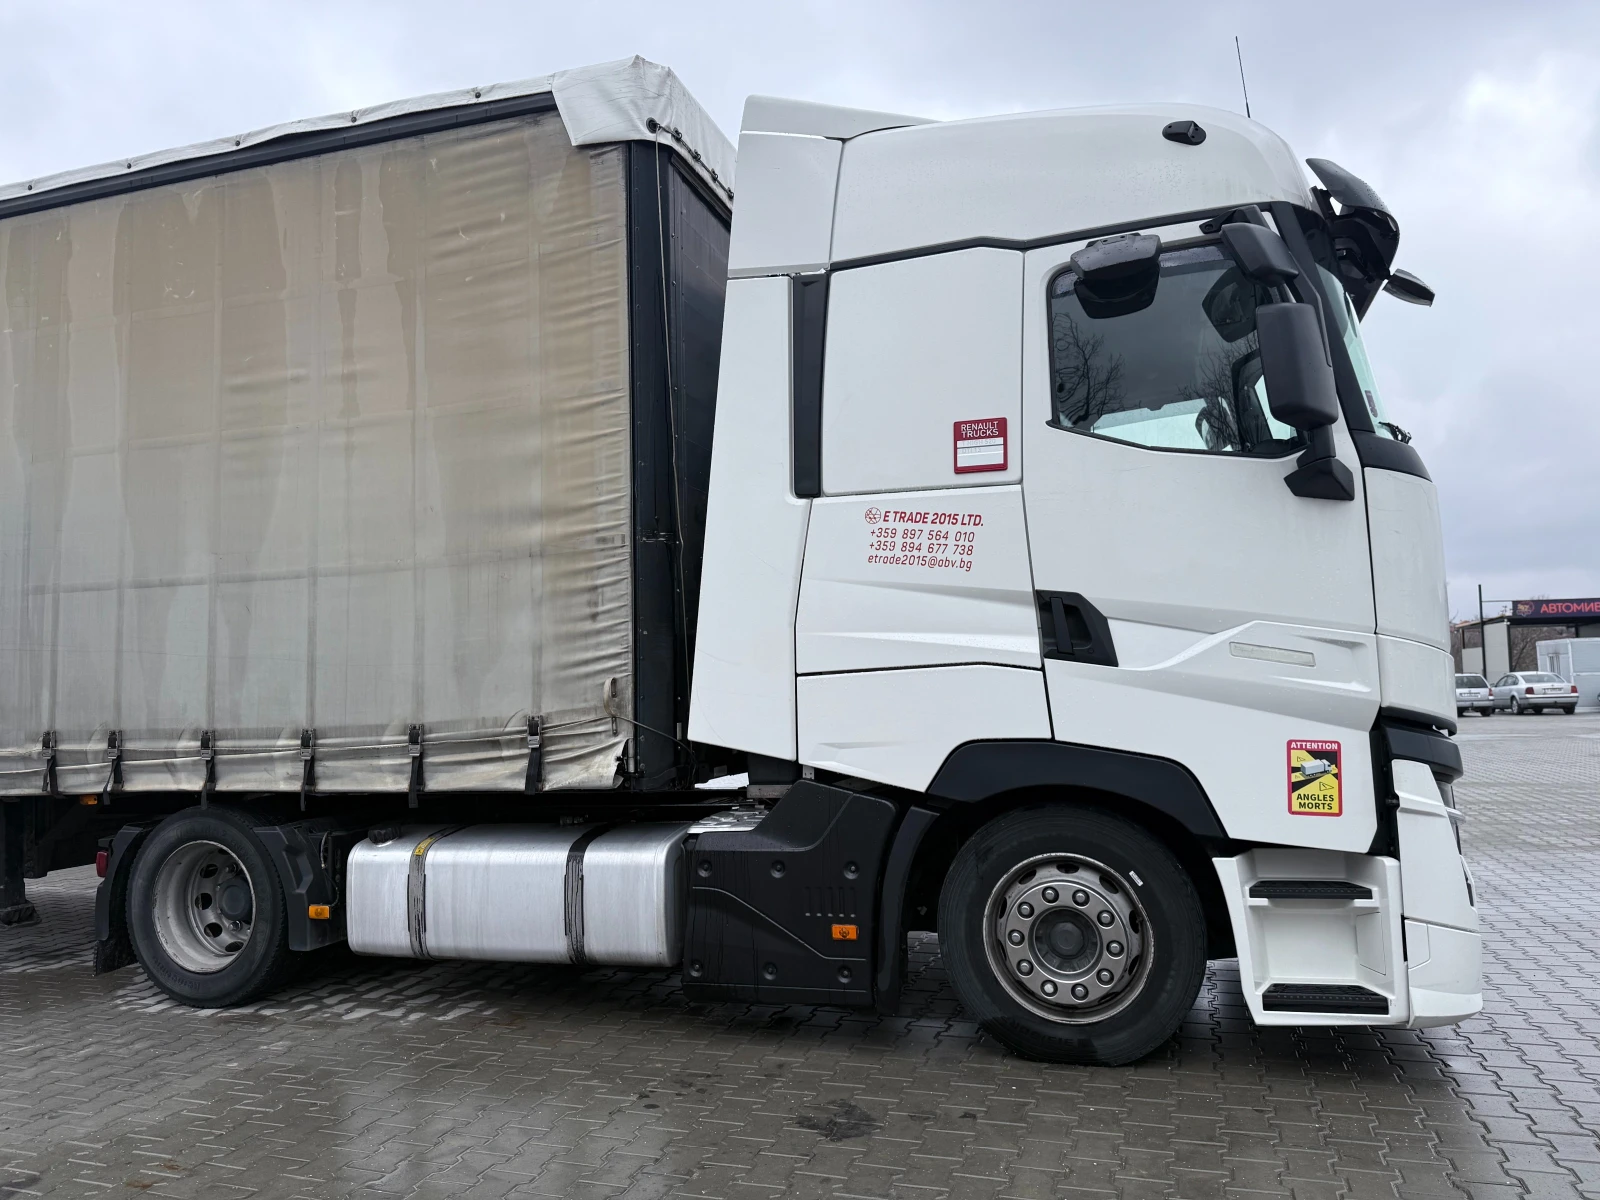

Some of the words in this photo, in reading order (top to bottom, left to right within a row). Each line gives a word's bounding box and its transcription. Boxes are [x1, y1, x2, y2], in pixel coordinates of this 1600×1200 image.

[961, 421, 998, 431] RENAULT
[961, 429, 998, 438] TRUCKS
[883, 511, 891, 522] E
[893, 511, 929, 524] TRADE
[931, 512, 958, 525] 2015
[961, 514, 984, 526] LTD.
[870, 527, 897, 539] +359
[902, 528, 923, 540] 897
[927, 530, 949, 541] 564
[954, 531, 975, 542] 010
[869, 541, 896, 551] +359
[900, 541, 922, 553] 894
[927, 542, 948, 554] 677
[953, 544, 974, 556] 738
[867, 554, 973, 572] etrade2015@abv.bg
[1291, 742, 1338, 750] ATTENTION
[1296, 793, 1334, 802] ANGLES
[1299, 802, 1332, 810] MORTS
